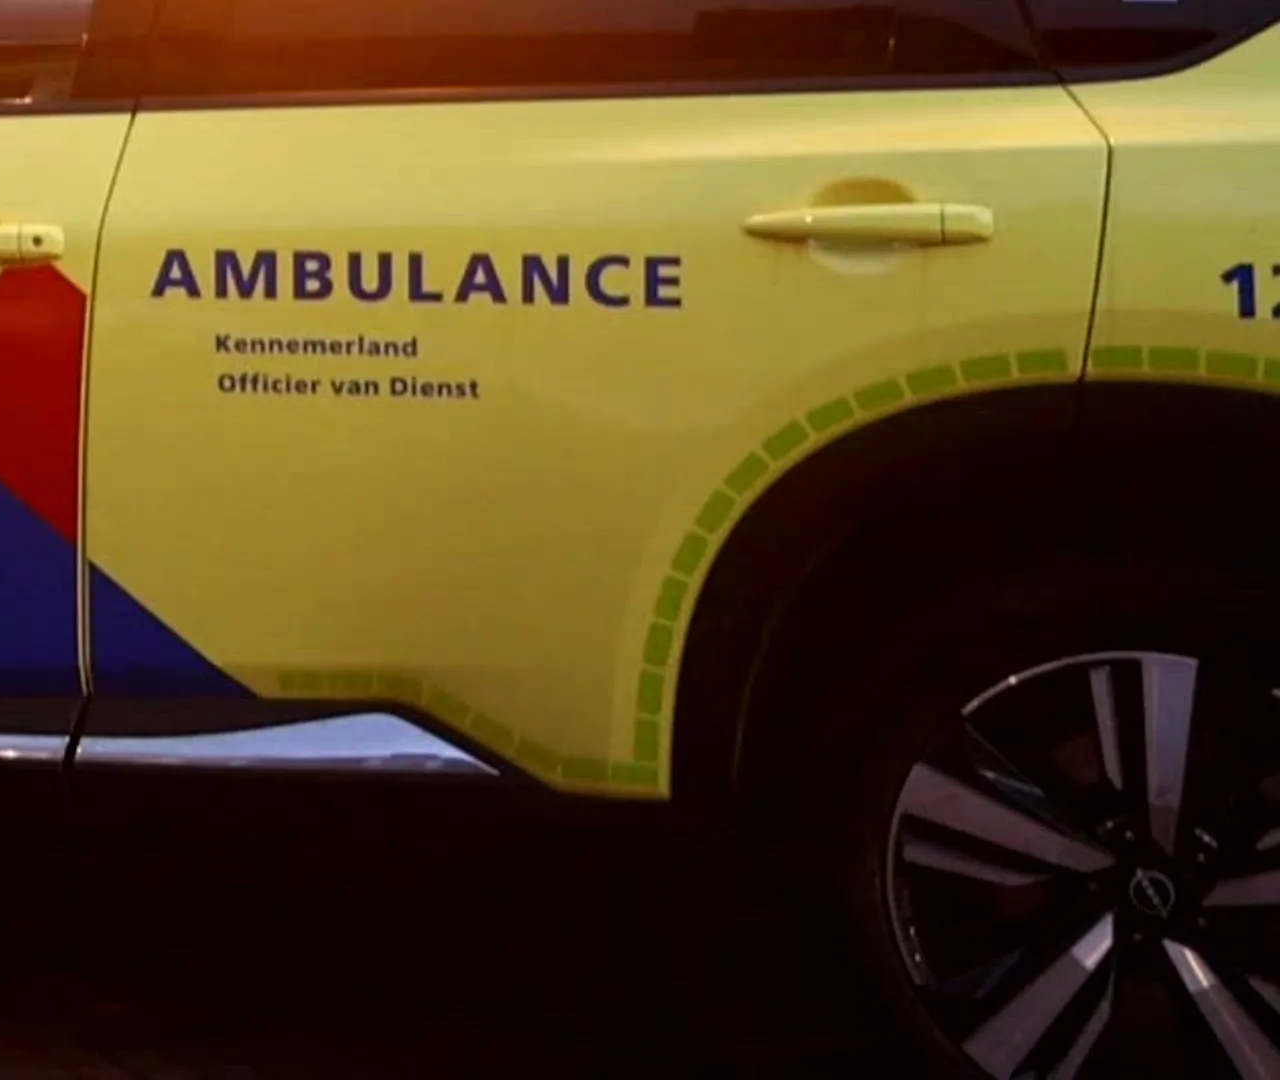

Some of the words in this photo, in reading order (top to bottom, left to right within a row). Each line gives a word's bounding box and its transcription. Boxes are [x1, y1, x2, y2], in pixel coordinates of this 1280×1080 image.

[149, 248, 683, 308] AMBULANCE
[214, 333, 419, 358] Kennemerland
[217, 372, 322, 395] Officier
[329, 378, 380, 398] van
[389, 376, 481, 400] Dienst
